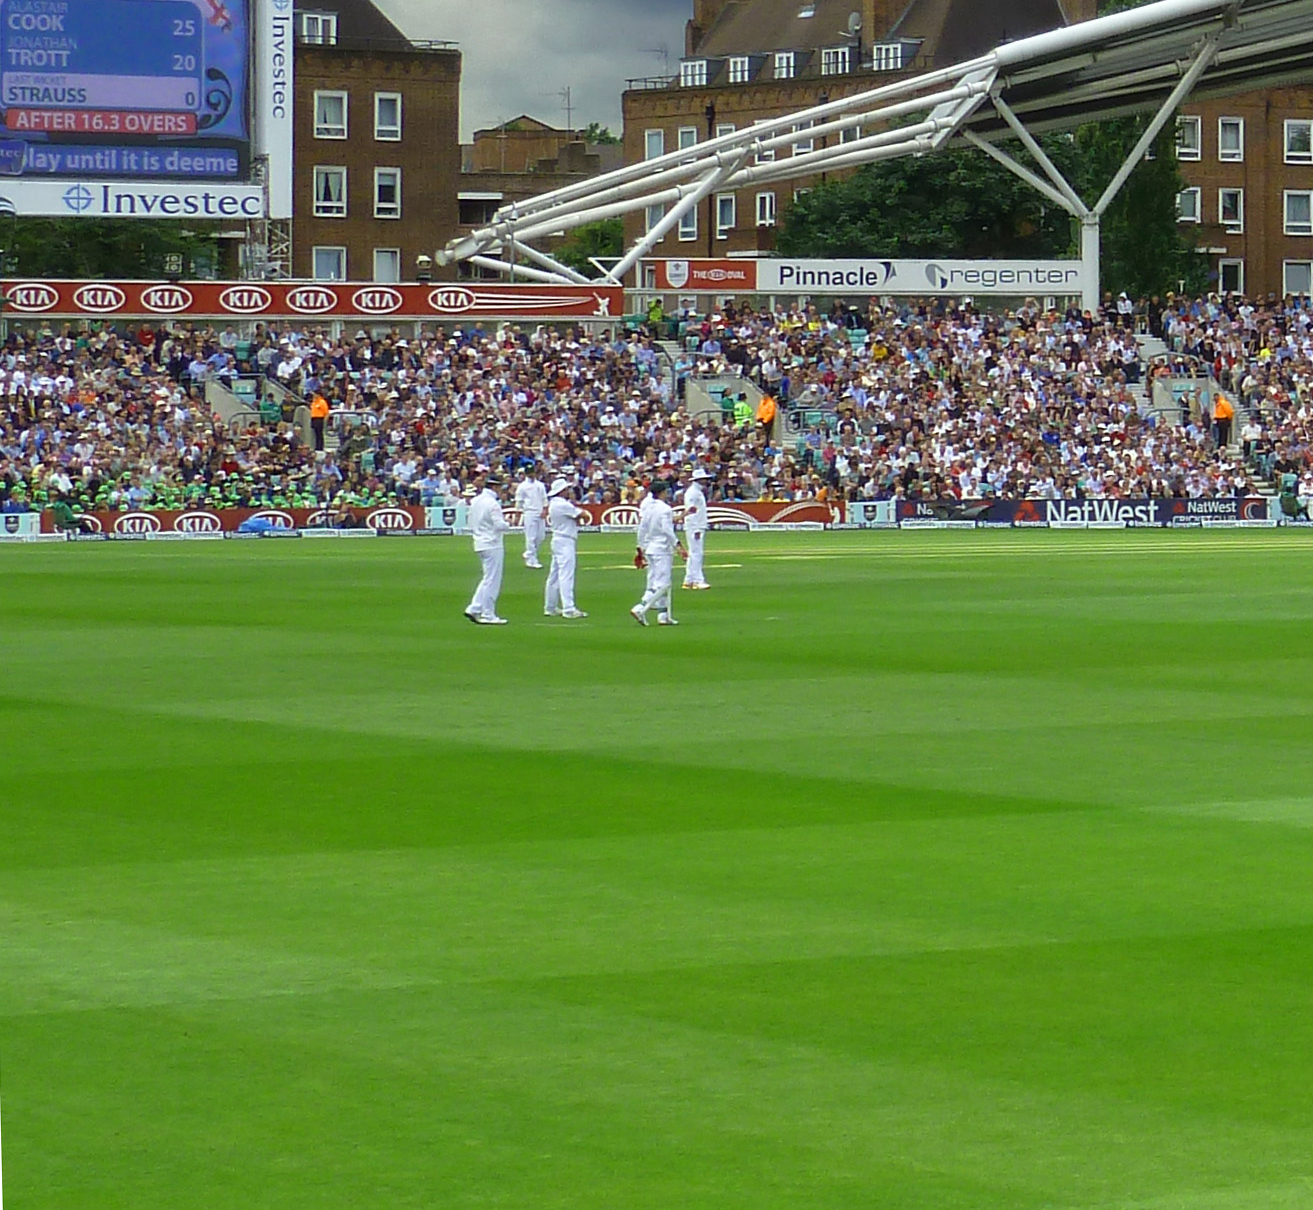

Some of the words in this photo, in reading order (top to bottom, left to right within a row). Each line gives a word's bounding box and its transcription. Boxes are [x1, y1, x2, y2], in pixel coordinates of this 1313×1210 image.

[9, 1, 68, 13] ALASTAIR
[8, 15, 64, 32] COOK
[173, 19, 195, 37] 25
[8, 49, 71, 68] TROTT
[173, 54, 196, 72] 20
[272, 16, 290, 120] Investec
[8, 86, 87, 104] STRAUSS
[185, 91, 196, 107] 0
[16, 111, 76, 131] AFTER
[81, 113, 120, 132] 16.3
[124, 115, 188, 132] OVERS
[66, 150, 116, 169] until
[121, 150, 139, 169] it
[143, 151, 159, 170] is
[164, 150, 239, 171] deeme
[102, 184, 262, 216] Investec
[692, 270, 708, 280] THE
[727, 270, 746, 280] OVAL
[779, 265, 878, 286] Pinnacle
[950, 266, 1078, 288] regenter
[16, 290, 49, 306] KIA
[83, 290, 117, 306] KIA
[150, 291, 184, 307] KIA
[229, 291, 263, 308] KIA
[295, 292, 329, 308] KIA
[361, 292, 395, 308] KIA
[437, 292, 469, 308] KIA
[1046, 499, 1159, 521] NatWest
[1187, 501, 1237, 513] NatWest
[122, 518, 152, 533] KIA
[182, 518, 211, 532] KIA
[374, 514, 404, 528] KIA
[610, 510, 640, 526] KIA
